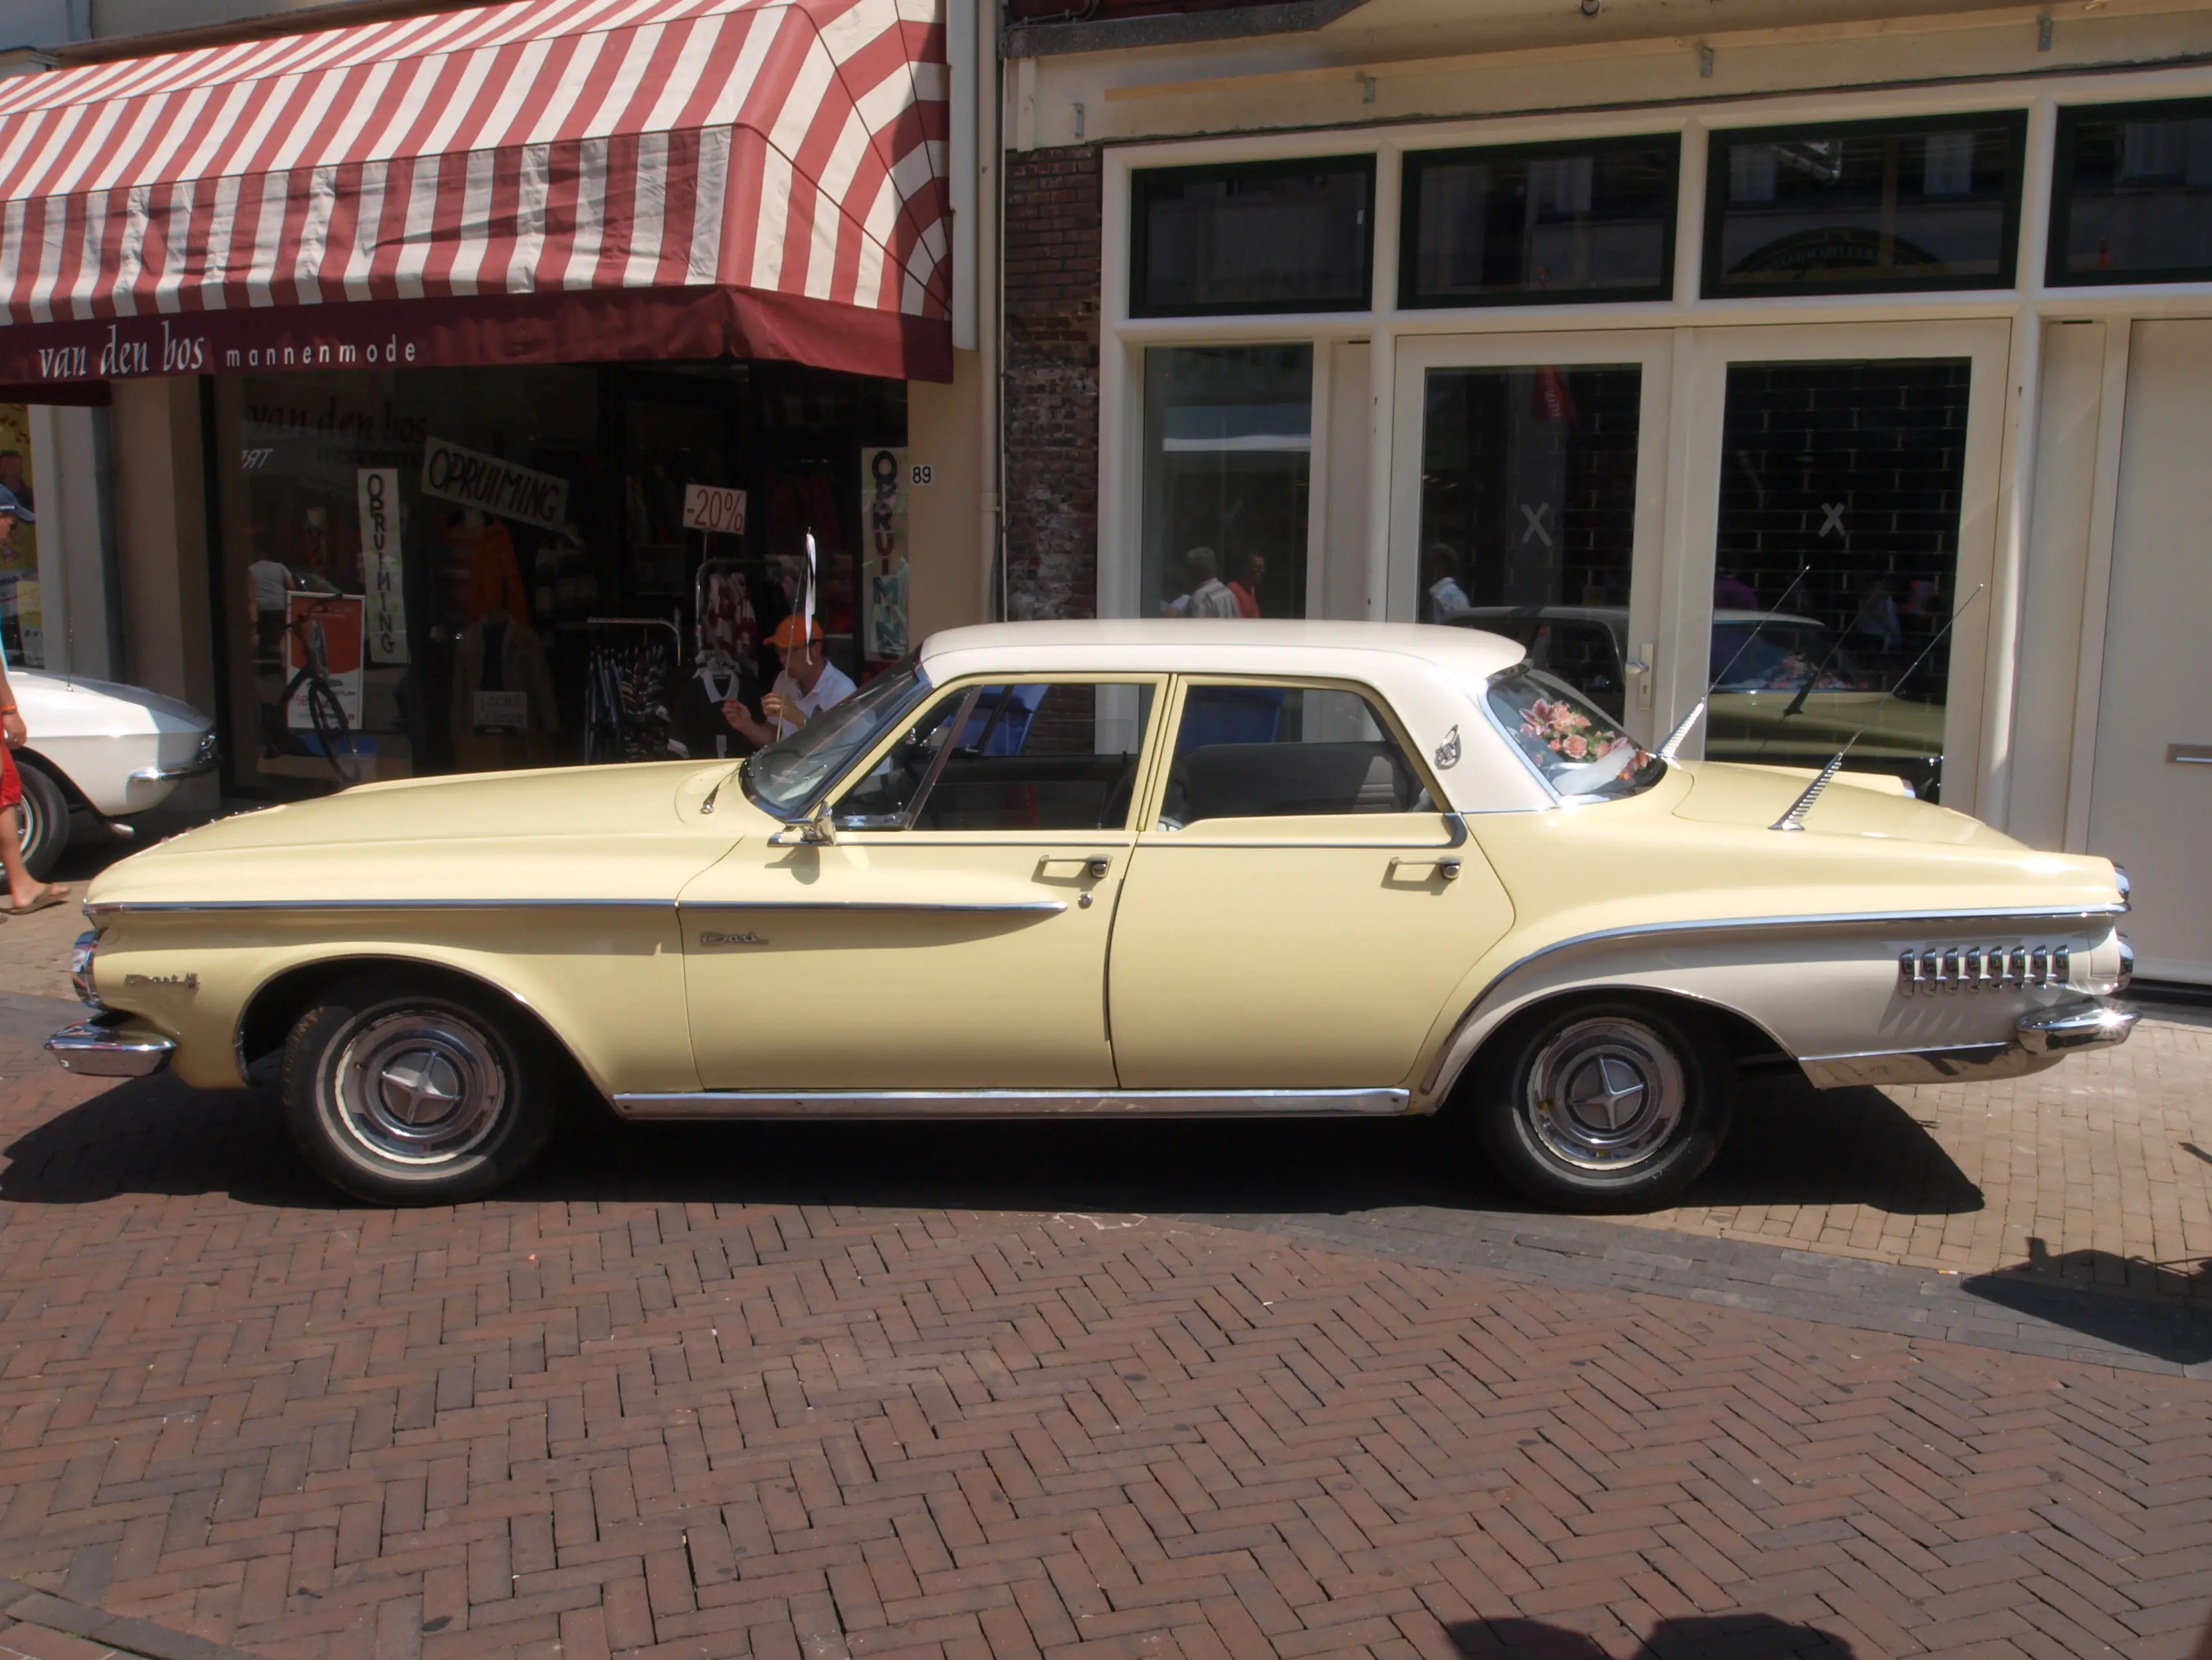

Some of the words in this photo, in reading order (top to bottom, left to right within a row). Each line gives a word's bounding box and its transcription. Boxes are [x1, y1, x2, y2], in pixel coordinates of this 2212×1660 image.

[39, 346, 87, 378] van
[100, 324, 150, 375] den
[162, 321, 205, 371] bos
[227, 334, 415, 366] mannenmode
[430, 448, 559, 521] OPRUIMING
[912, 467, 931, 484] 89
[687, 489, 743, 532] -20%
[367, 474, 395, 654] OPRUIMING
